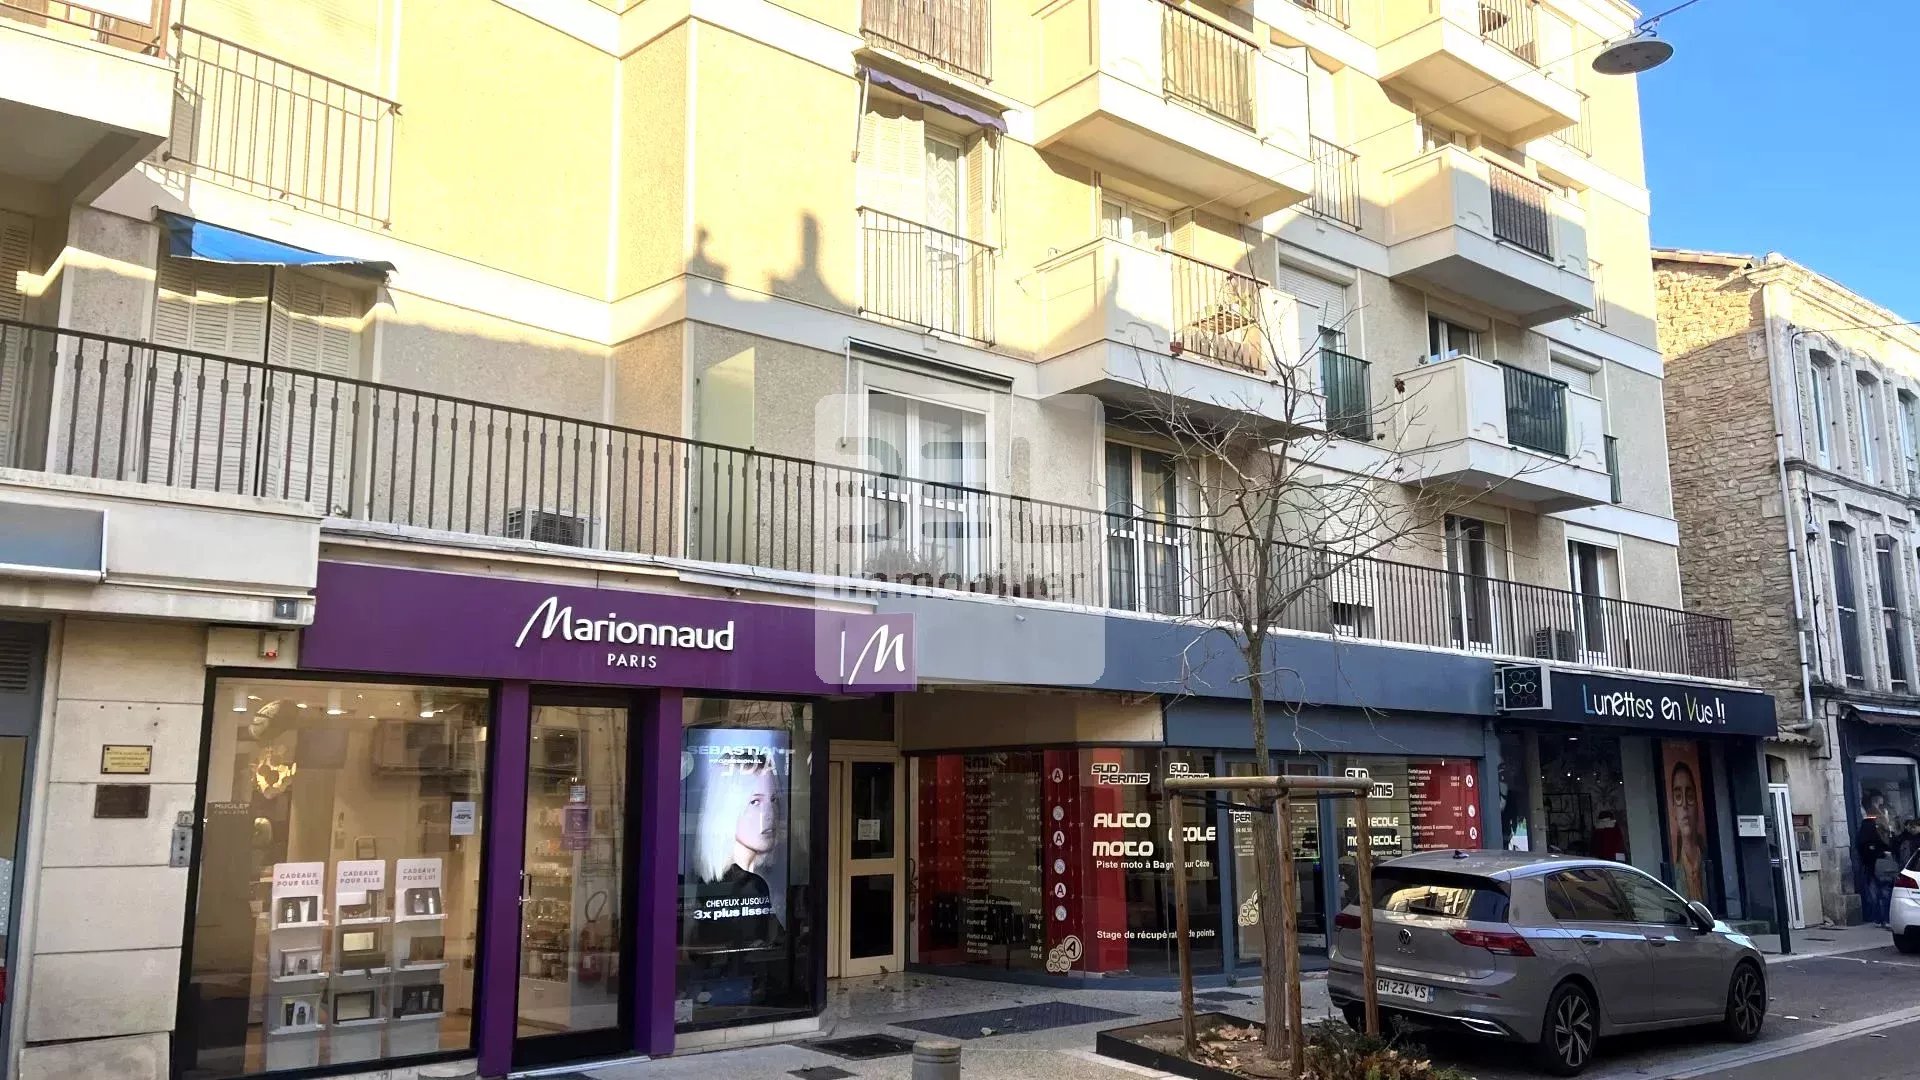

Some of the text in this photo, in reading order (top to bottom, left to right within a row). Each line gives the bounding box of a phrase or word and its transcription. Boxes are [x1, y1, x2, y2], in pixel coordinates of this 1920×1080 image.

[281, 603, 288, 614] 1
[515, 595, 734, 651] Marionnaud
[848, 624, 906, 685] M
[607, 653, 657, 669] PARIS
[1582, 684, 1654, 719] Lunettes
[1661, 696, 1681, 721] en
[1684, 693, 1713, 724] Vue
[1092, 763, 1119, 774] SUD
[1170, 763, 1189, 774] SUD
[1099, 773, 1150, 784] PERMIS
[1093, 813, 1151, 828] AUTO
[1371, 817, 1399, 827] ECOLE
[1373, 835, 1400, 846] ECOLE
[1093, 841, 1154, 857] MOTO
[1146, 860, 1151, 868] à
[706, 898, 739, 908] CHEVEUX
[693, 906, 776, 920] 3x plus lisses
[1096, 930, 1122, 941] Stage
[1124, 930, 1135, 939] de
[1197, 929, 1215, 938] points
